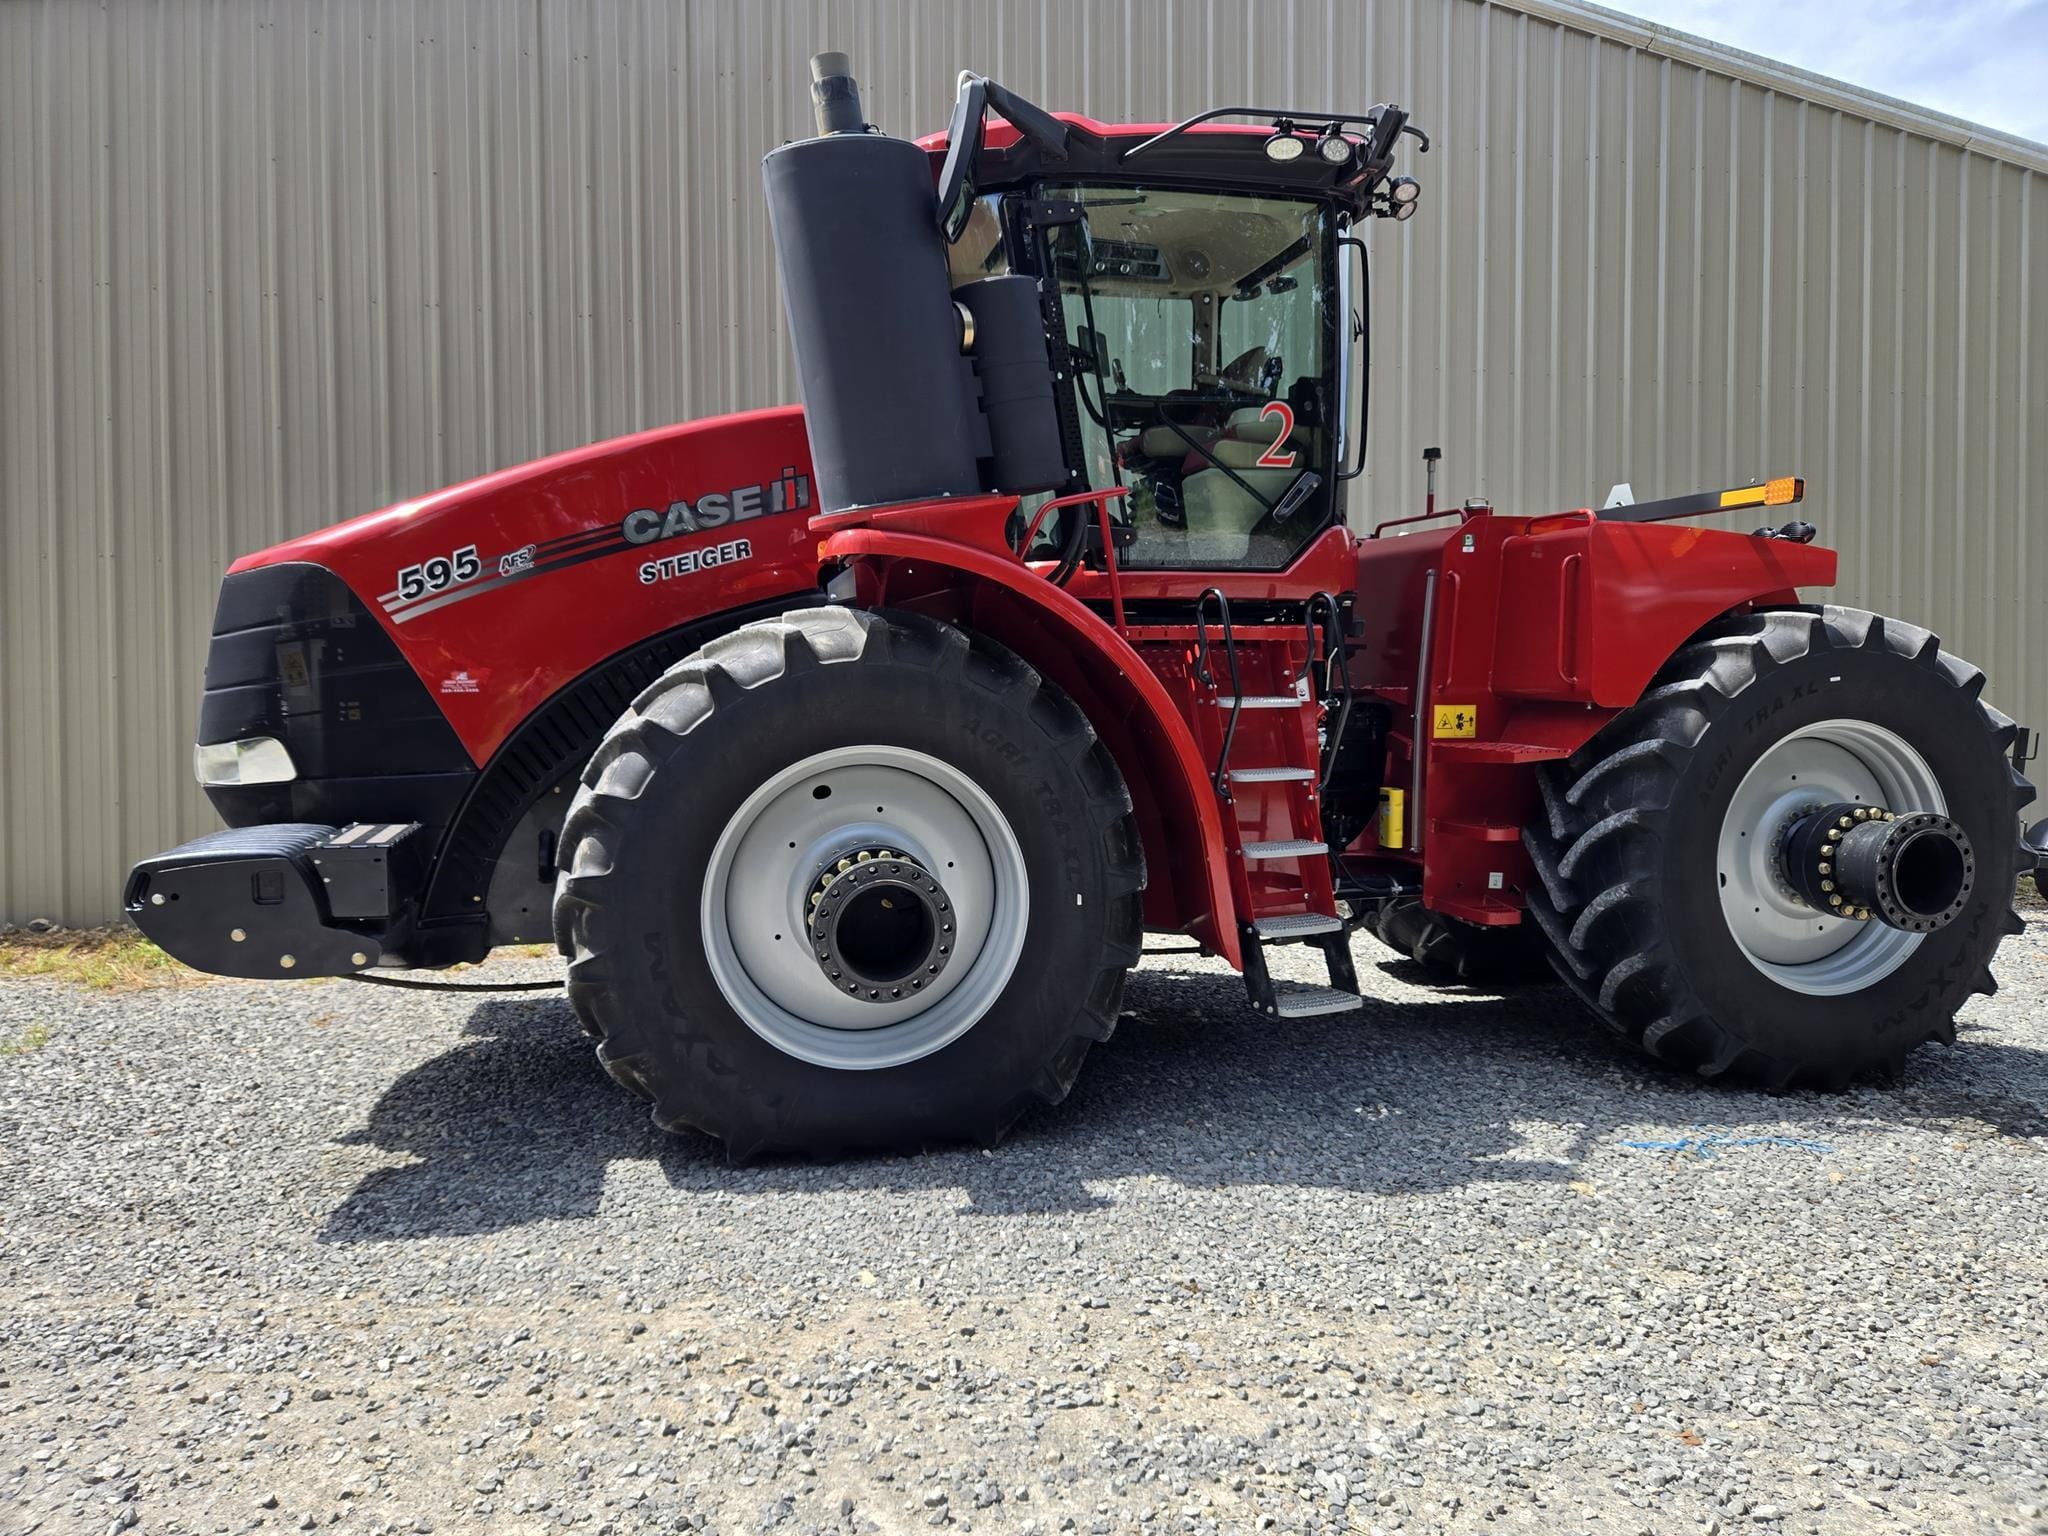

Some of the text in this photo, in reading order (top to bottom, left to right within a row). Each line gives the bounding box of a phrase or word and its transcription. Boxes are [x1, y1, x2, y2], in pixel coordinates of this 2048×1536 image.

[1256, 400, 1296, 468] 2
[621, 484, 763, 545] CASE
[398, 544, 482, 600] 595
[500, 550, 529, 571] AFS
[639, 538, 753, 584] STEIGER
